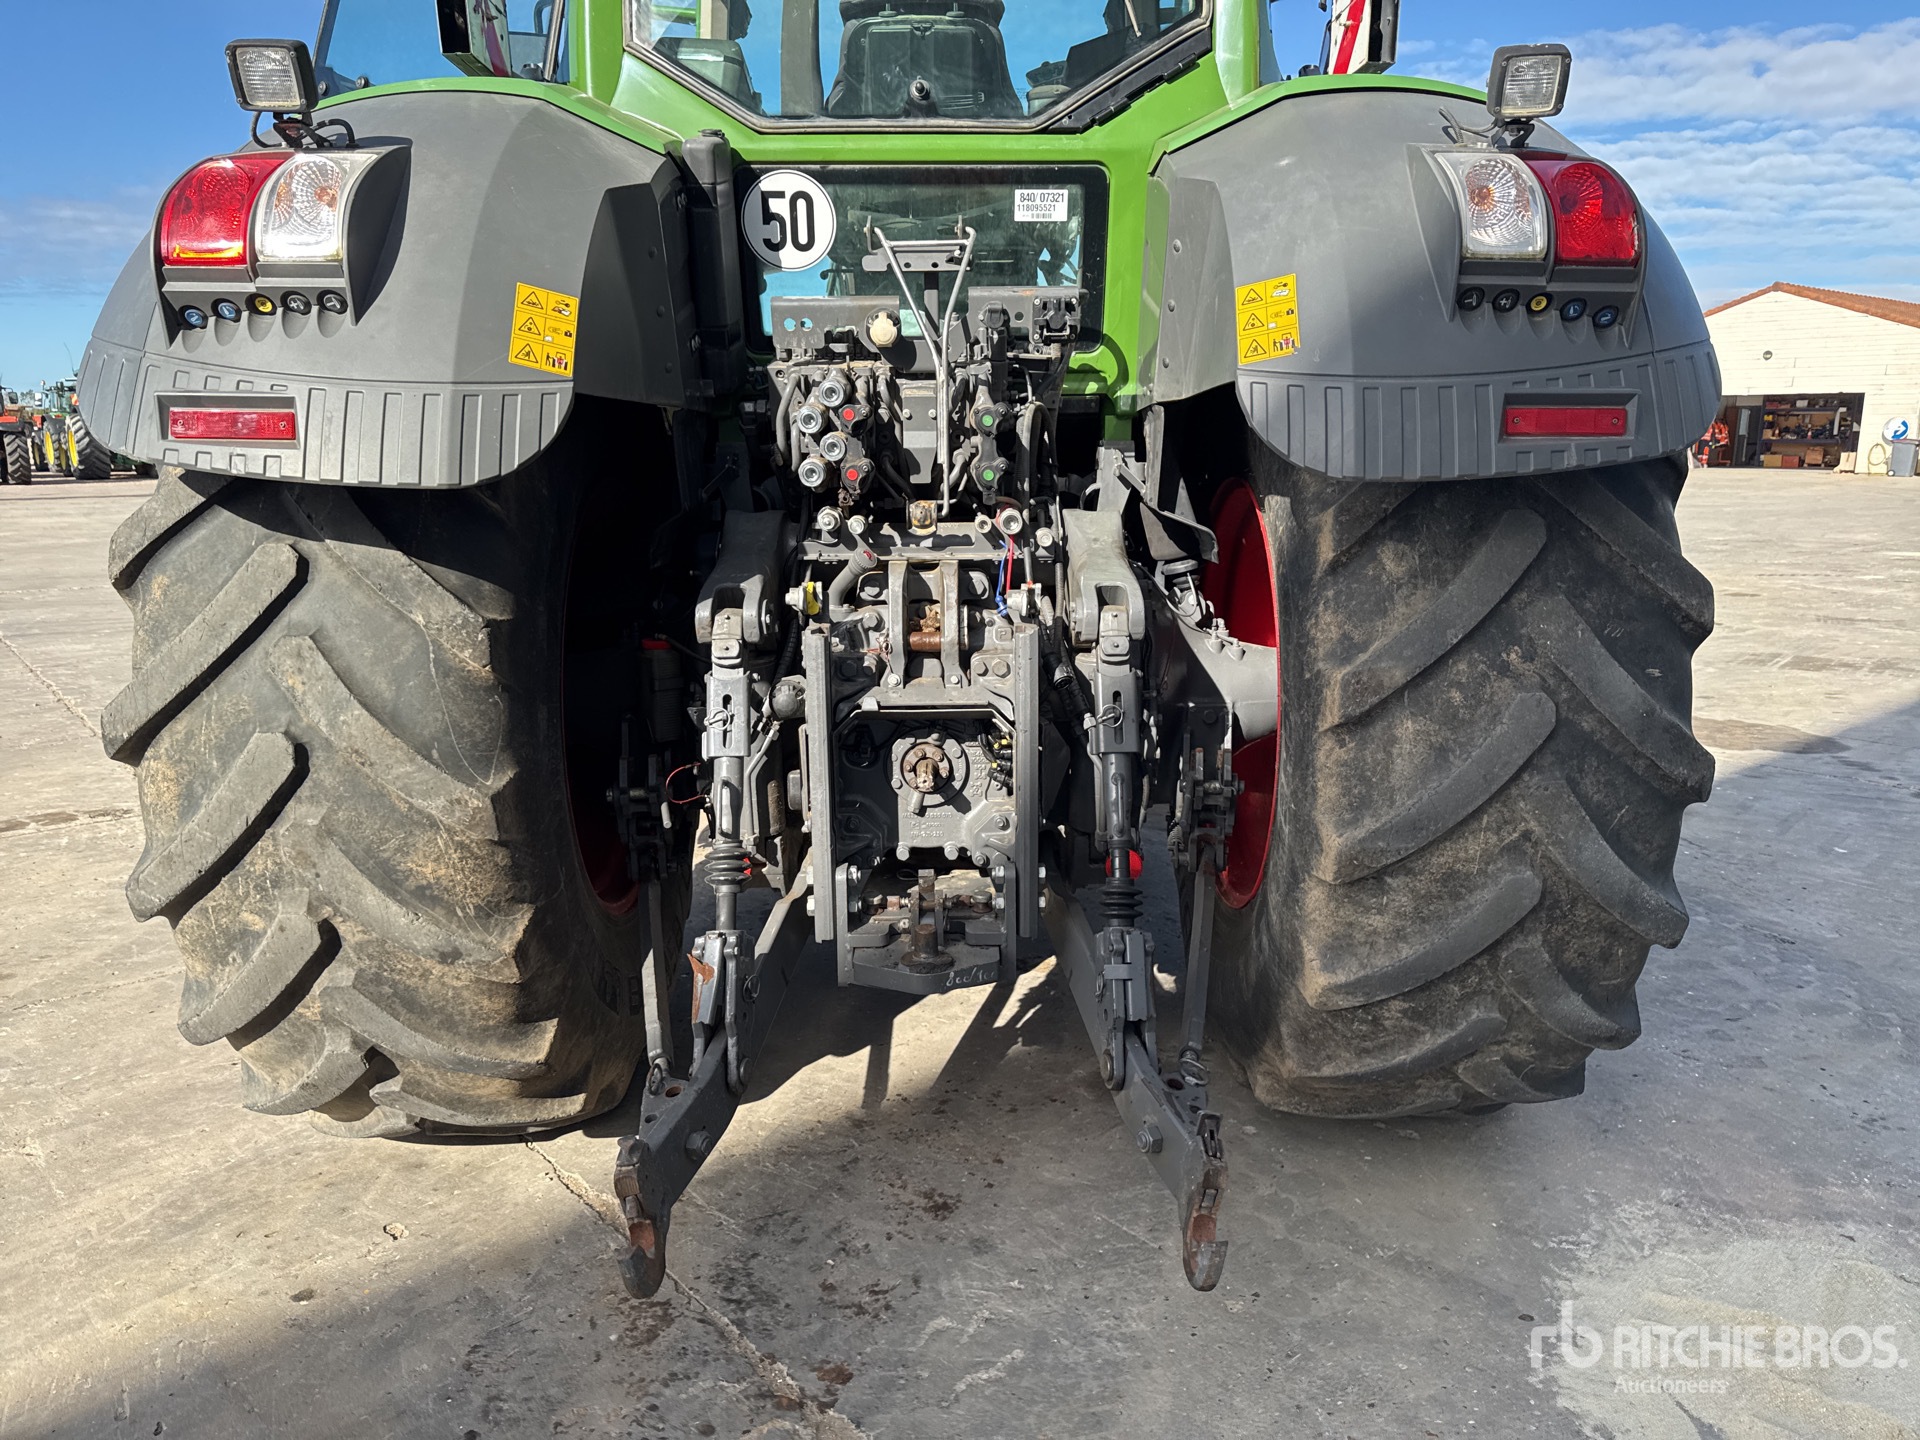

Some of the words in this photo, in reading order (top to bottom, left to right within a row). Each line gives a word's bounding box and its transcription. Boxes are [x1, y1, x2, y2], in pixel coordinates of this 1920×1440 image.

[1040, 192, 1064, 203] 07321
[1017, 204, 1056, 212] 118095521
[761, 190, 815, 253] 50
